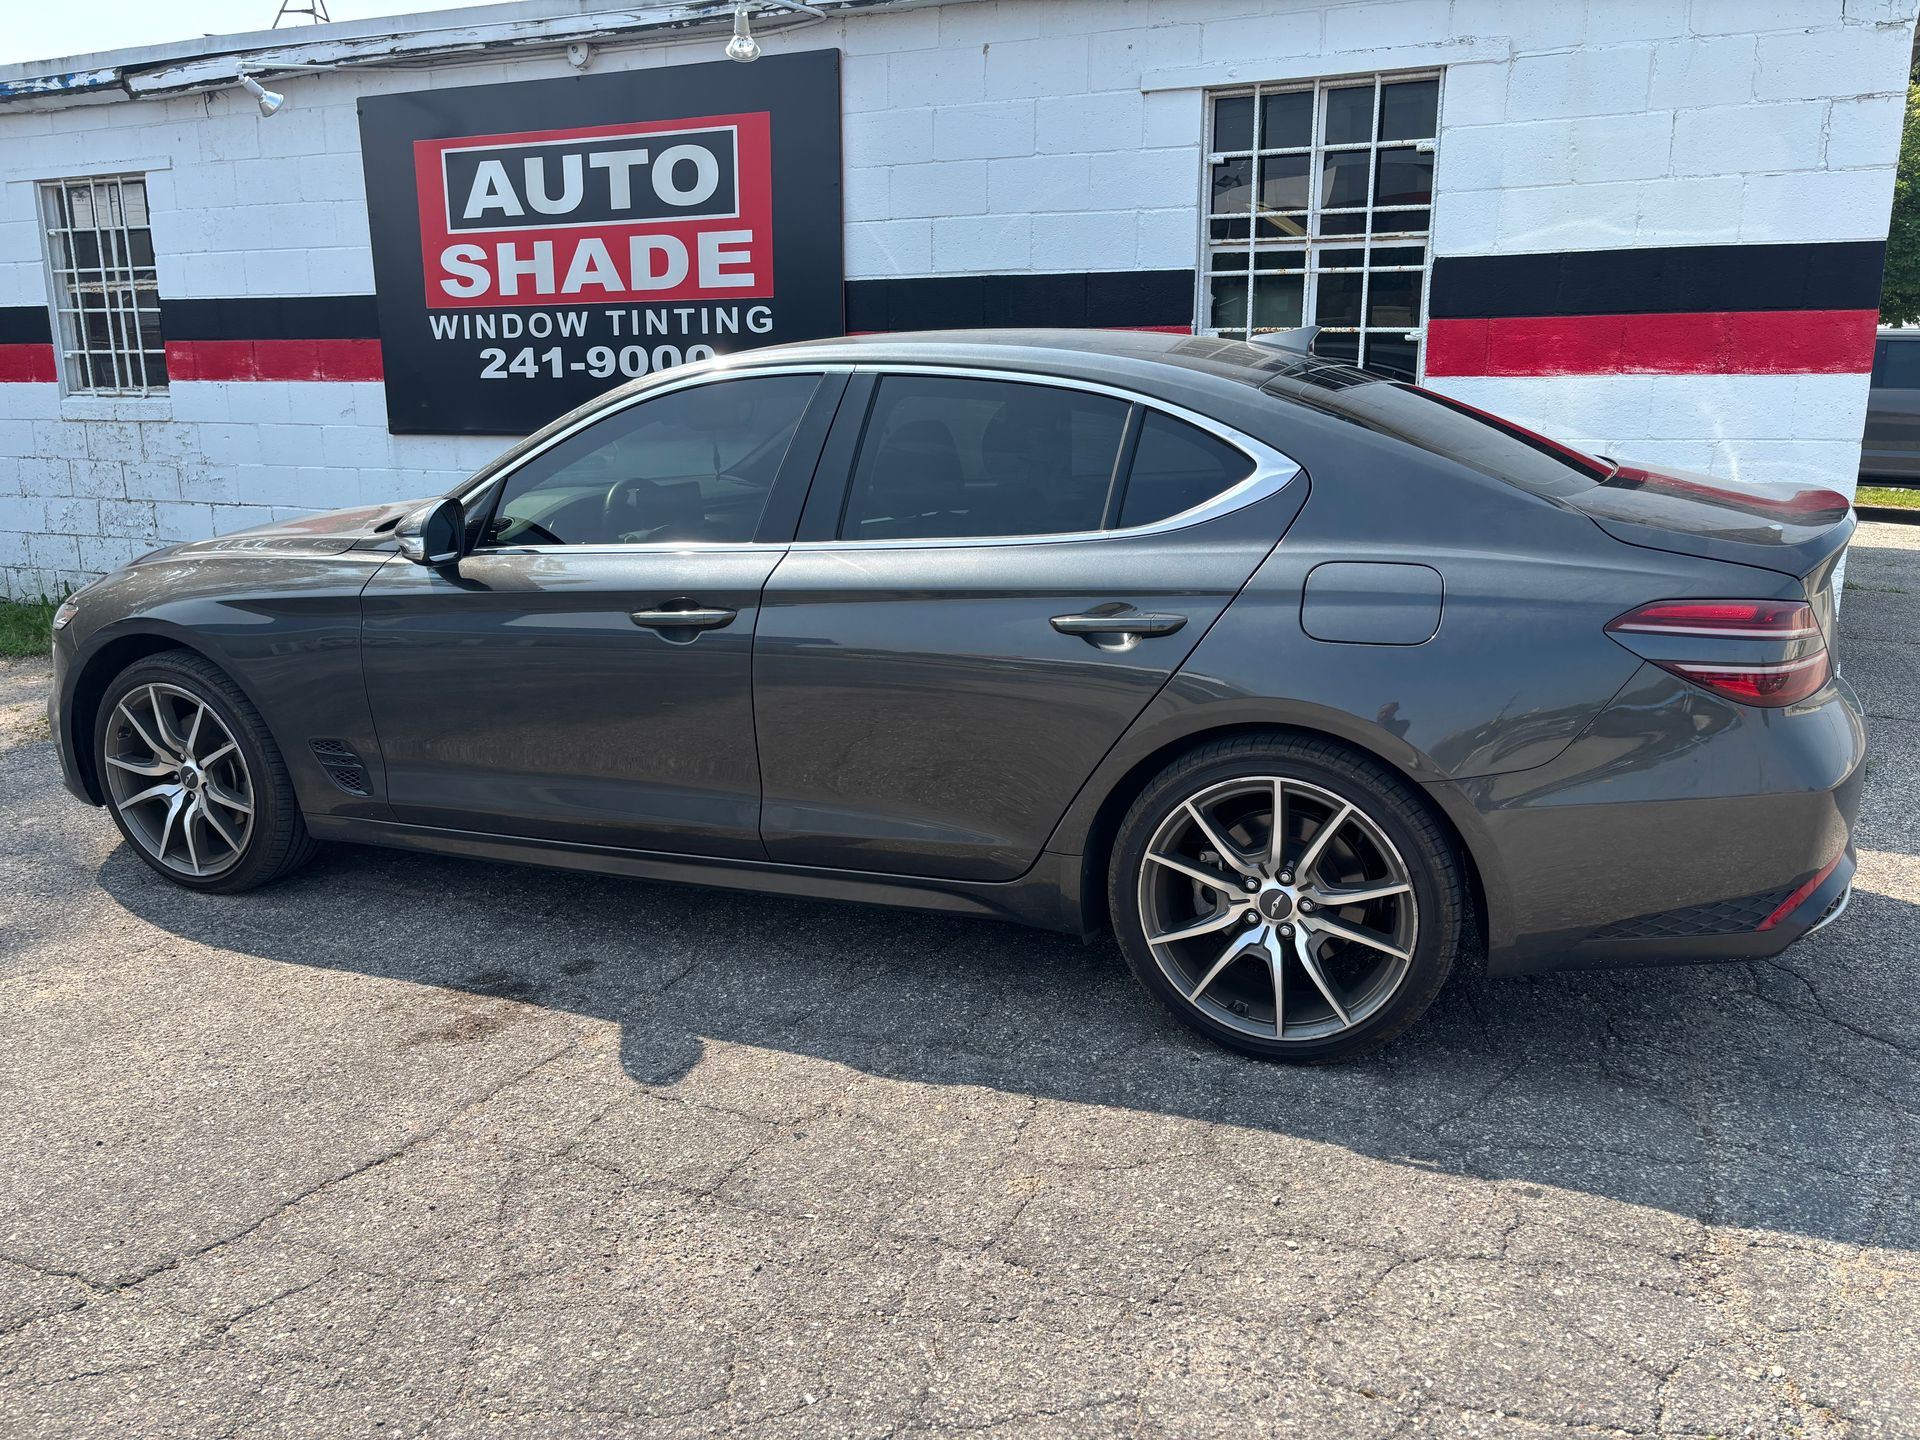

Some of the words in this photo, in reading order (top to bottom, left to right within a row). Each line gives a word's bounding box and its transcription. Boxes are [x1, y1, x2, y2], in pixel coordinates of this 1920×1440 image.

[463, 144, 719, 219] AUTO
[439, 229, 755, 298] SHADE
[429, 312, 589, 341] WINDOW
[605, 305, 774, 336] TINTING
